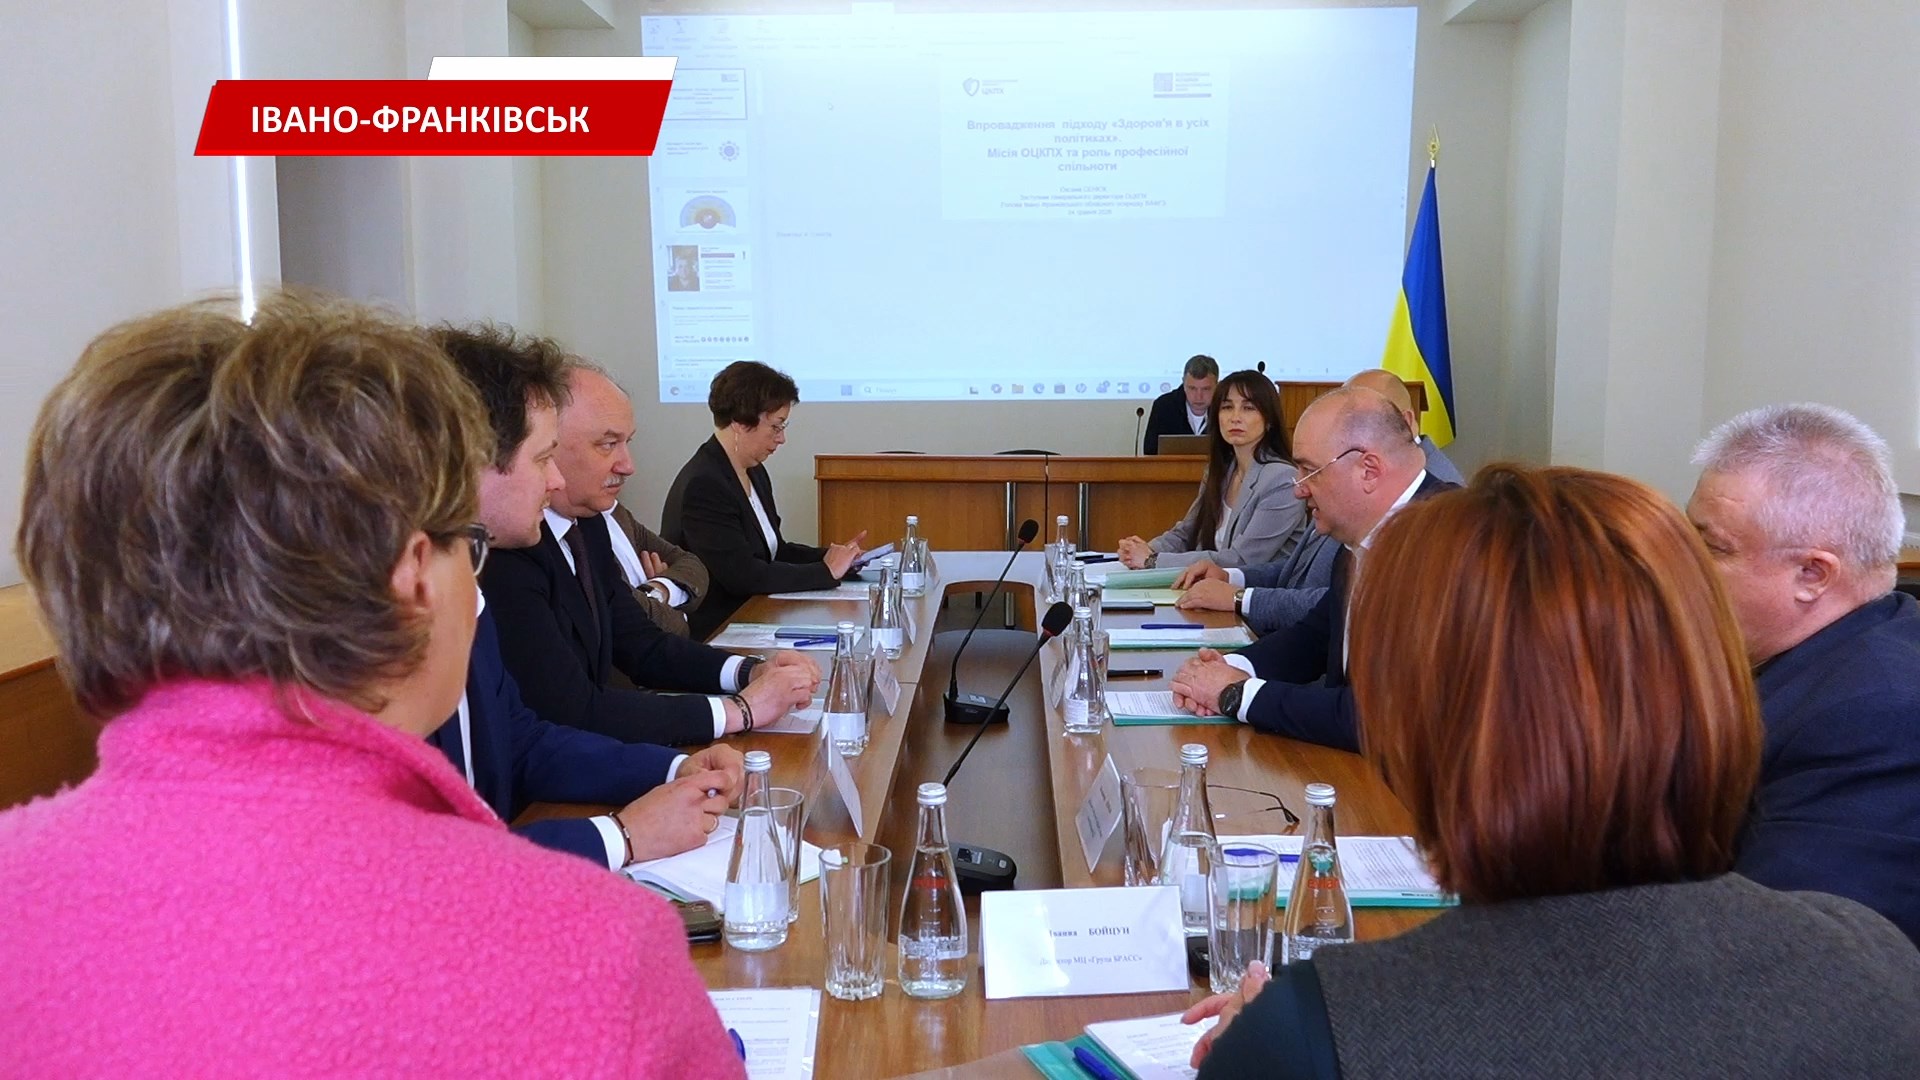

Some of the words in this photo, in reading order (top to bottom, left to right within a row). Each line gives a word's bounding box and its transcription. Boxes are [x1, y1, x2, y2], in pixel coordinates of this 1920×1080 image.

[967, 119, 1056, 131] Впровадження
[1062, 119, 1108, 131] підходу
[1176, 120, 1184, 129] в
[1186, 118, 1210, 131] усіх
[987, 147, 1018, 158] Місія
[1020, 147, 1063, 159] ОЦКПХ
[1066, 149, 1079, 158] та
[1082, 149, 1111, 159] роль
[1114, 146, 1189, 159] професійної
[1058, 161, 1118, 173] спільноти
[1088, 926, 1131, 937] БОЙЦУН
